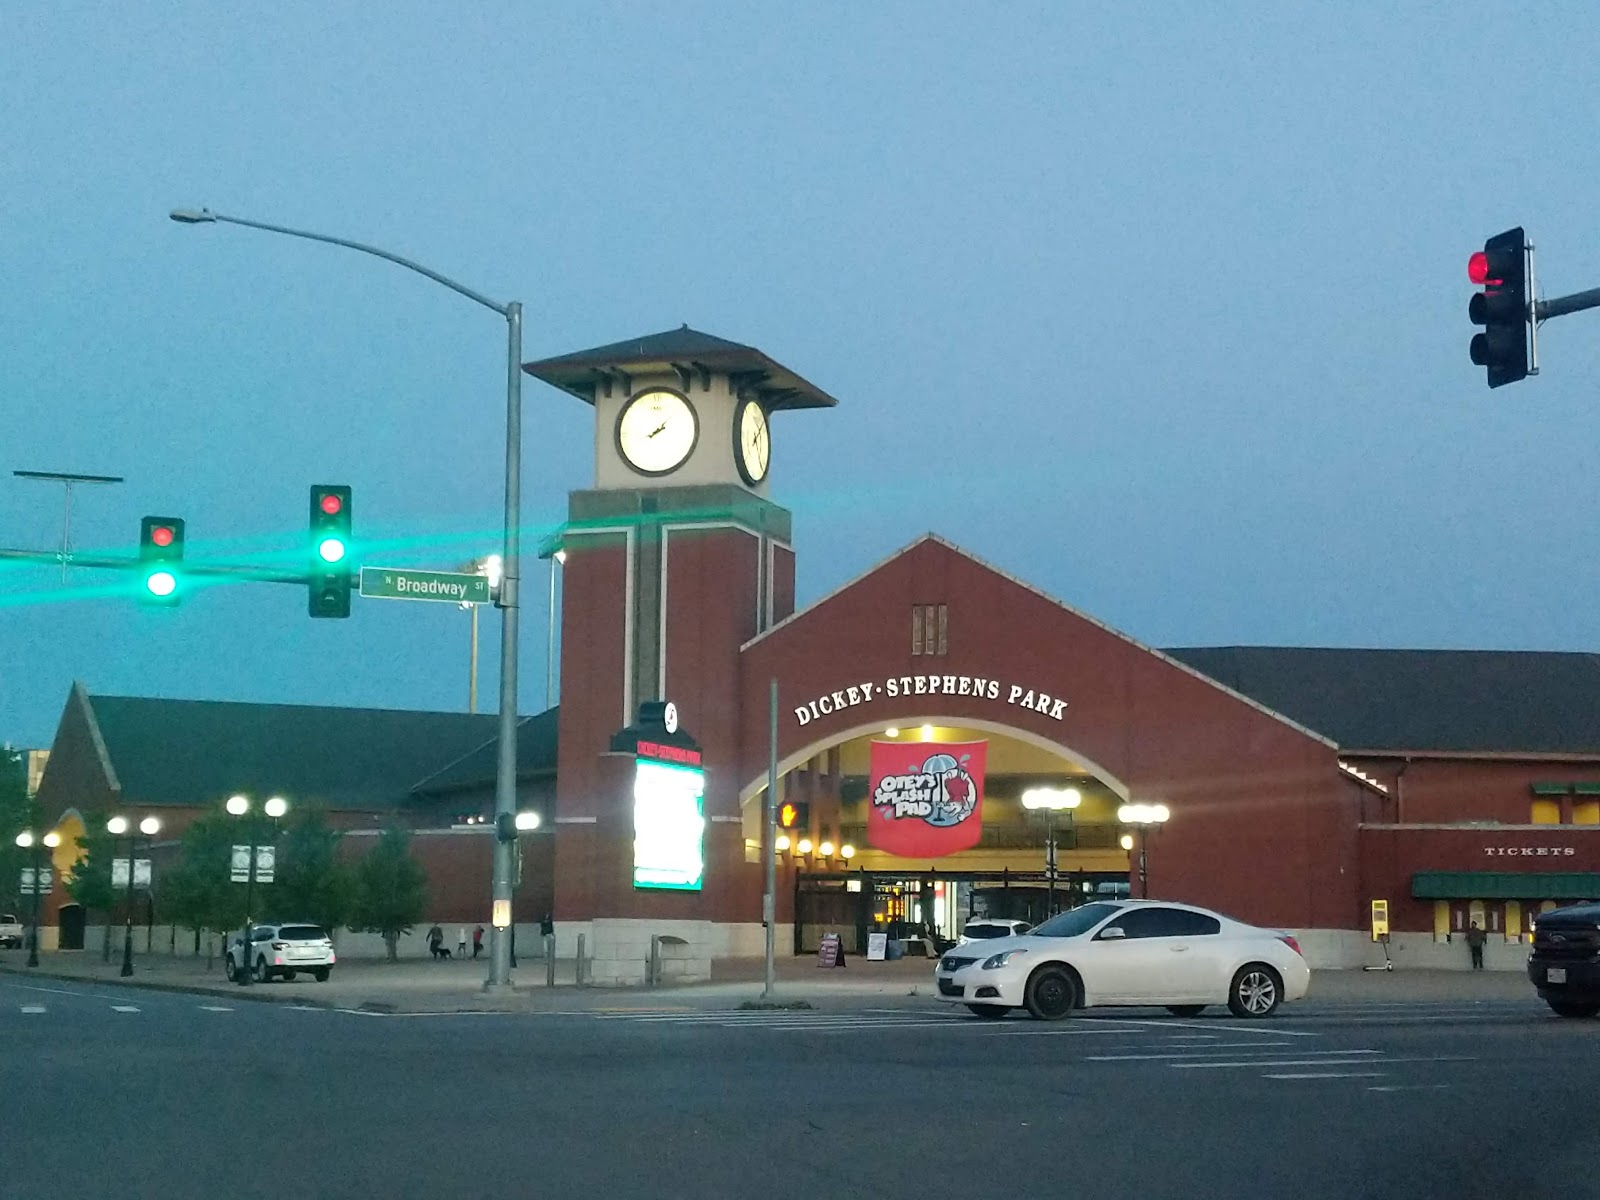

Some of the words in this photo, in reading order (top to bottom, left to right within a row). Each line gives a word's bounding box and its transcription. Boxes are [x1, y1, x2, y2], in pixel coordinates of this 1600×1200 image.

[397, 577, 467, 598] Broadway
[1008, 685, 1068, 721] PARK
[874, 787, 932, 805] SPLASH
[895, 801, 932, 818] PAD
[1484, 847, 1575, 856] TICKETS
